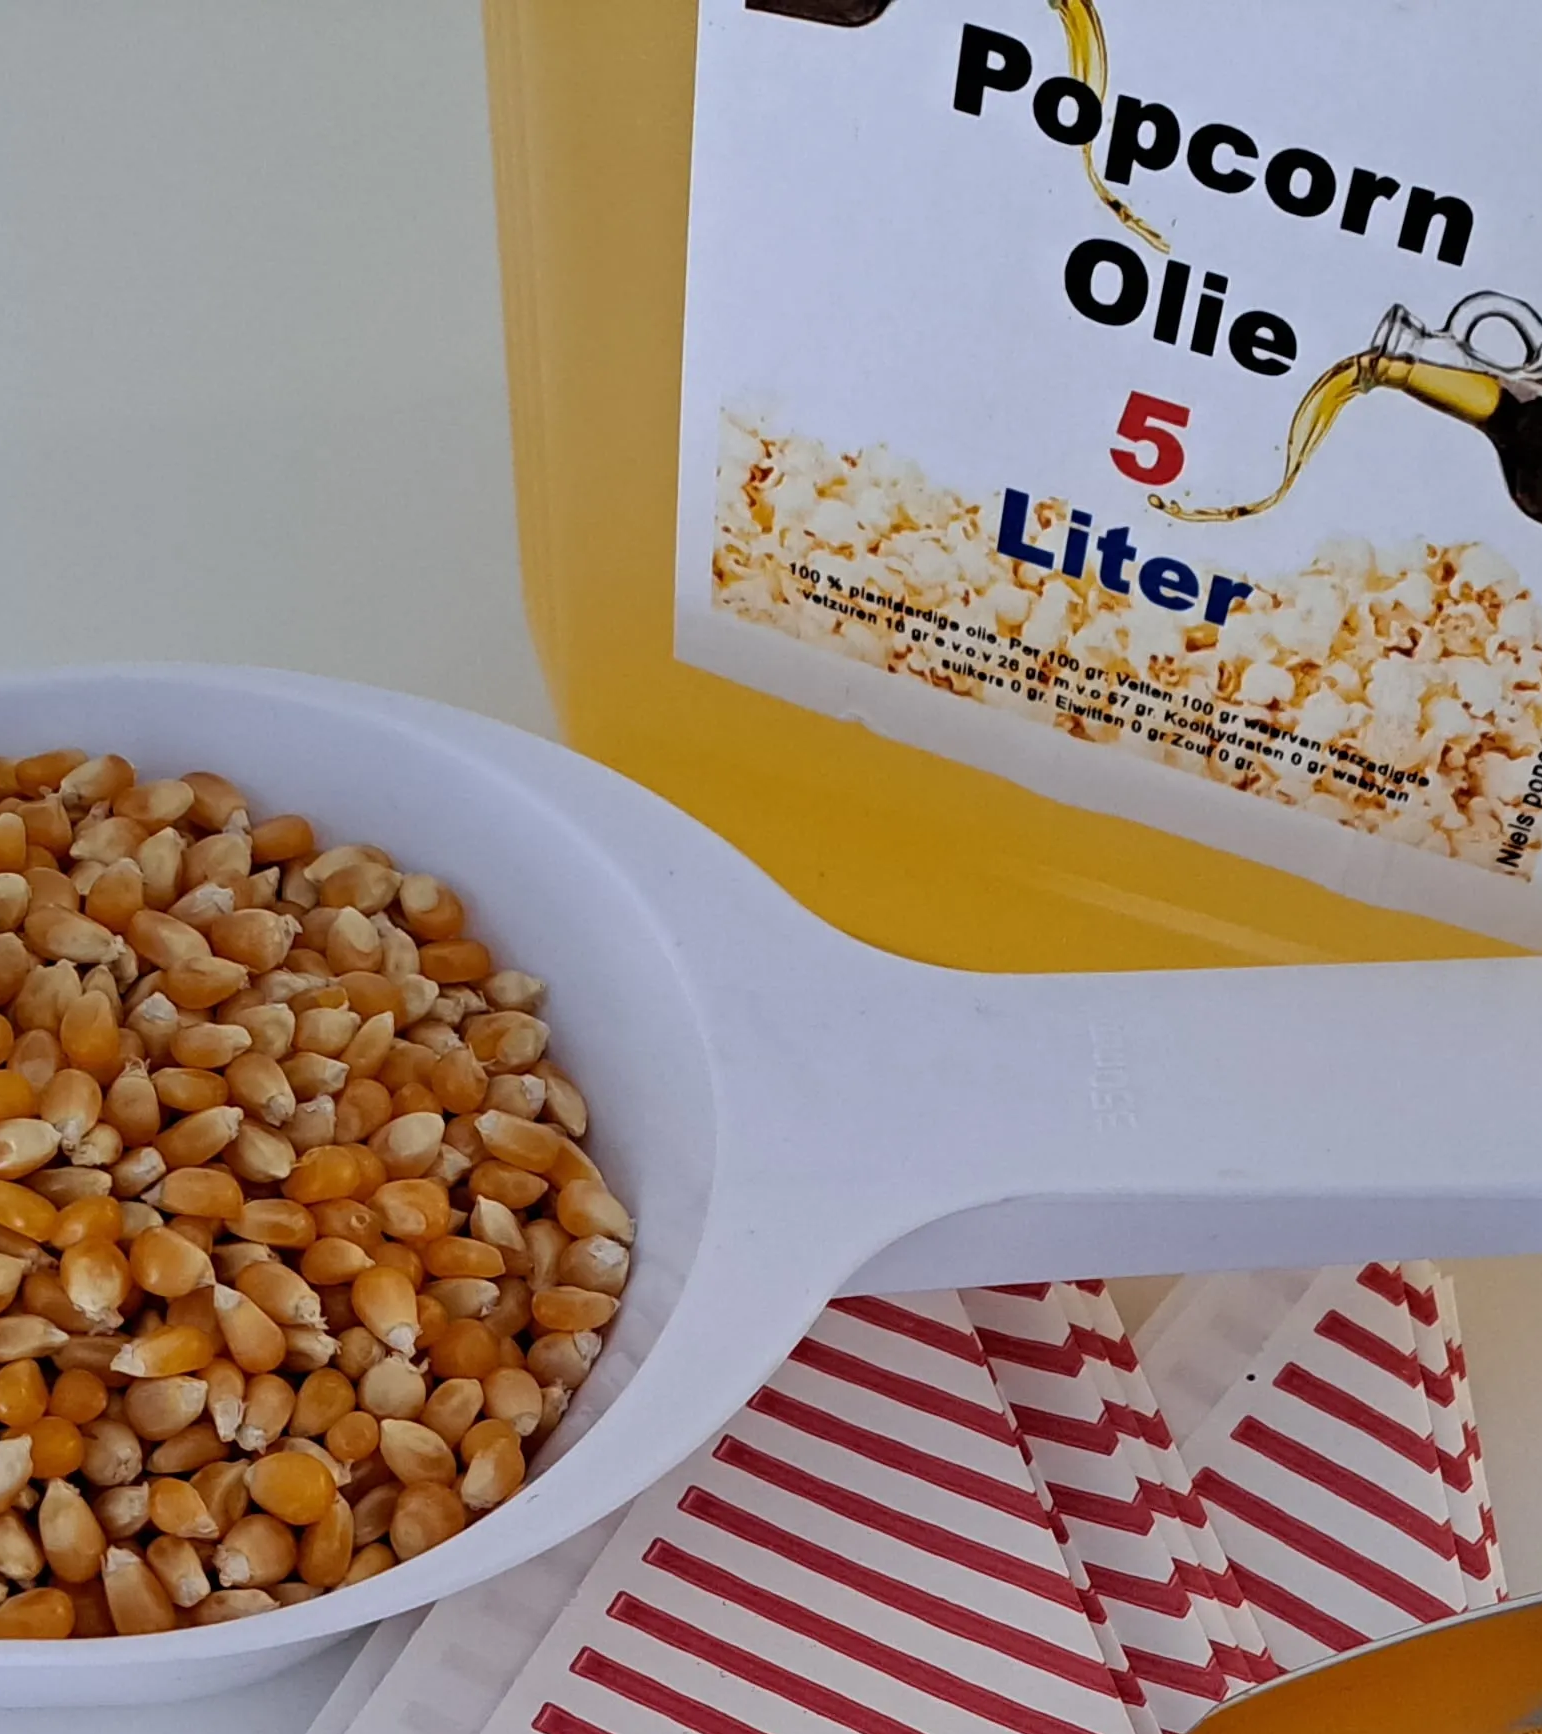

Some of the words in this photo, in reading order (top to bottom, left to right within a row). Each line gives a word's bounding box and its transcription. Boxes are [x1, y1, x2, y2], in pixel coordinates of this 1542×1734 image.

[951, 22, 1477, 267] Popcorn
[1063, 237, 1299, 378] Olie
[1109, 391, 1191, 486] 5
[996, 487, 1253, 628] Liter
[789, 562, 820, 584] 100
[827, 575, 843, 591] %
[849, 584, 960, 633] plantaardige
[966, 625, 1002, 647] olie.
[1009, 637, 1039, 658] Per
[1046, 650, 1079, 672] 100
[1116, 672, 1174, 703] Vetten
[1182, 694, 1214, 716] 100
[1219, 708, 1239, 725] gr
[1245, 716, 1321, 752] waarvan
[1328, 742, 1430, 788] verzadigde
[802, 589, 878, 625] vetzuren
[911, 628, 930, 644] gr
[1164, 711, 1284, 762] Koolhydraten
[1290, 752, 1302, 767] 0
[1307, 759, 1327, 776] gr
[1333, 768, 1410, 803] waarvan
[941, 658, 1004, 687] suikers
[1011, 679, 1022, 693] 0
[1055, 695, 1125, 729] Eiwitten
[1131, 720, 1142, 735] 0
[1170, 731, 1213, 757] Zout
[1219, 748, 1230, 763] 0
[1496, 811, 1535, 868] Niels
